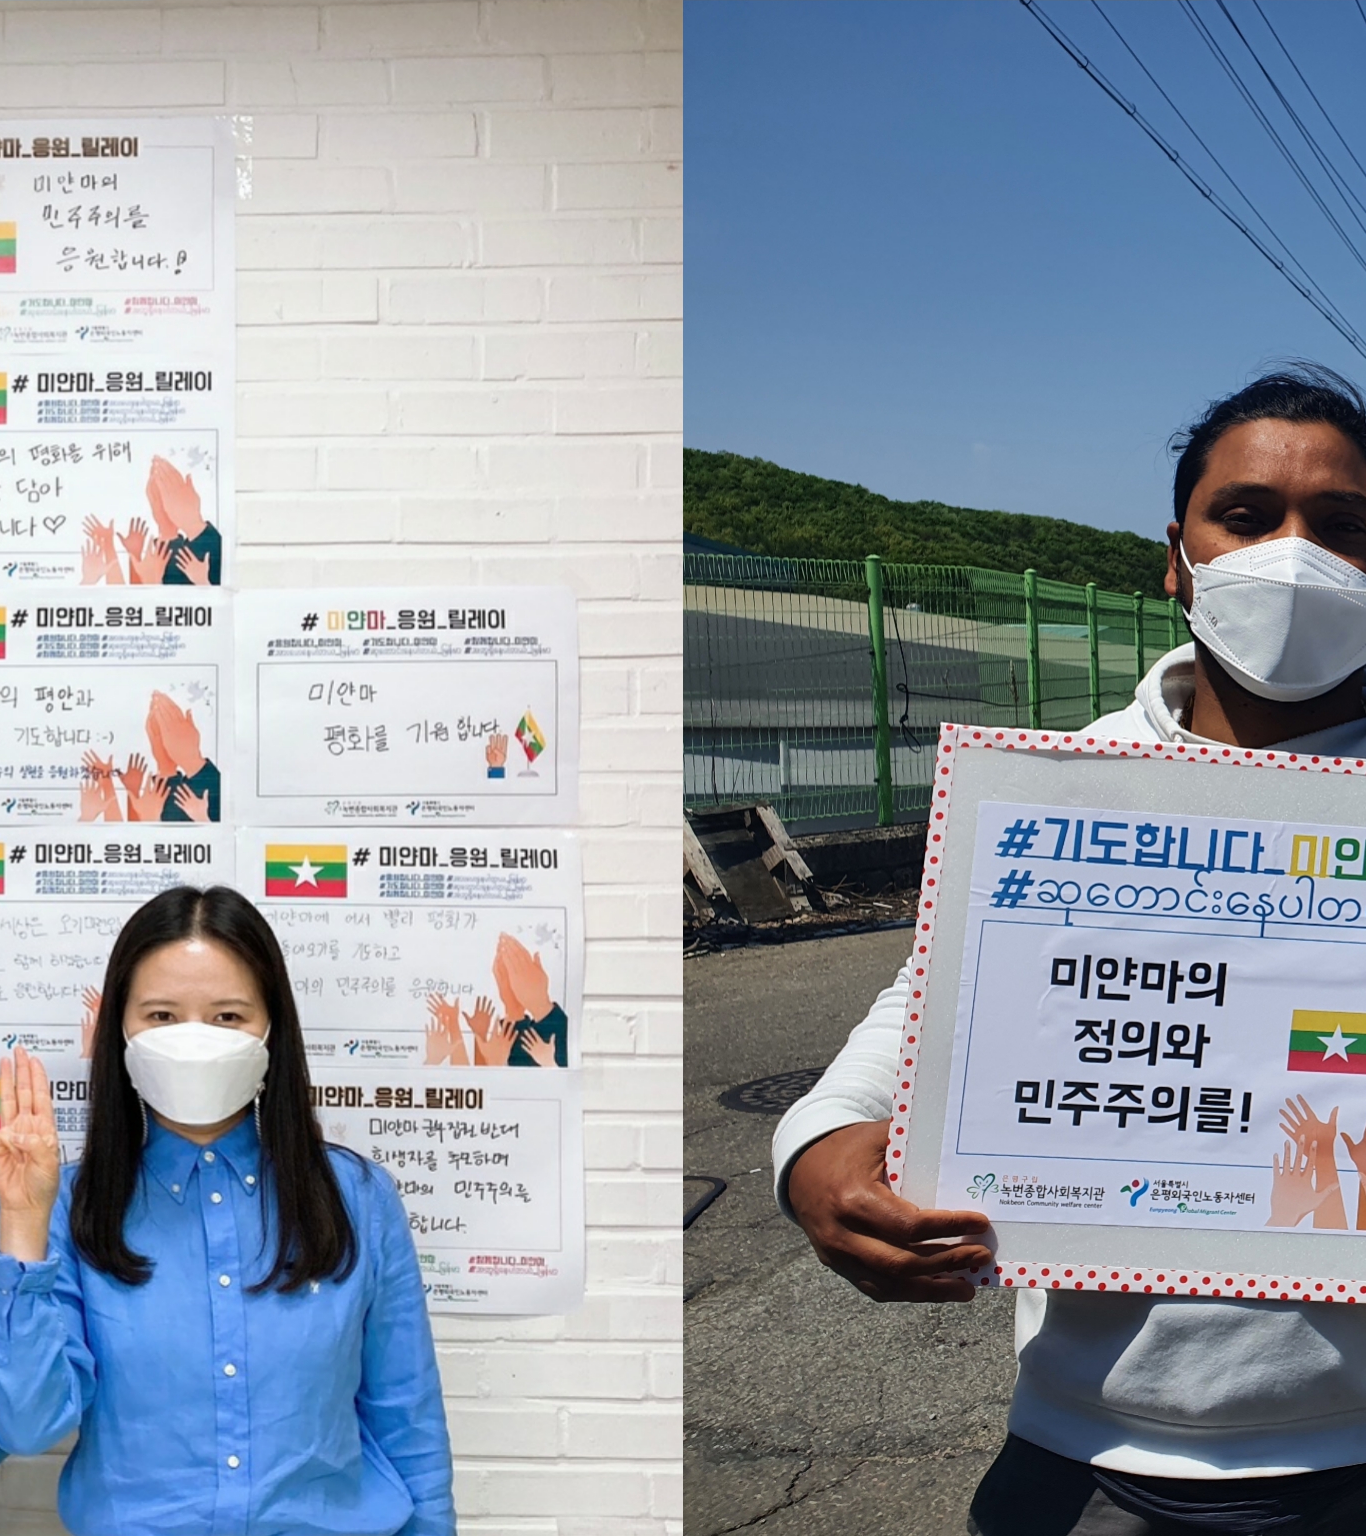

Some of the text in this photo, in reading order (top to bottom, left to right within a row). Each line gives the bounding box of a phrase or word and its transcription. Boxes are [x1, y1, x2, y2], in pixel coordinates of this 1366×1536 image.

[34, 171, 117, 194] 미얀마의
[42, 204, 149, 229] 민주주의를
[309, 680, 377, 706] 미얀마
[324, 725, 389, 756] 평화를
[352, 847, 557, 869] # 미얀마_응원_릴레이
[1051, 955, 1227, 1006] 미얀마의
[1074, 1019, 1210, 1068] 정의와
[1015, 1080, 1252, 1134] 민주주의를!
[1001, 1184, 1105, 1202] 녹번종합사회복지관
[1150, 1188, 1255, 1204] 은평외국인노동자센터
[1153, 1180, 1189, 1188] 서울특별시
[1027, 1200, 1059, 1208] Community
